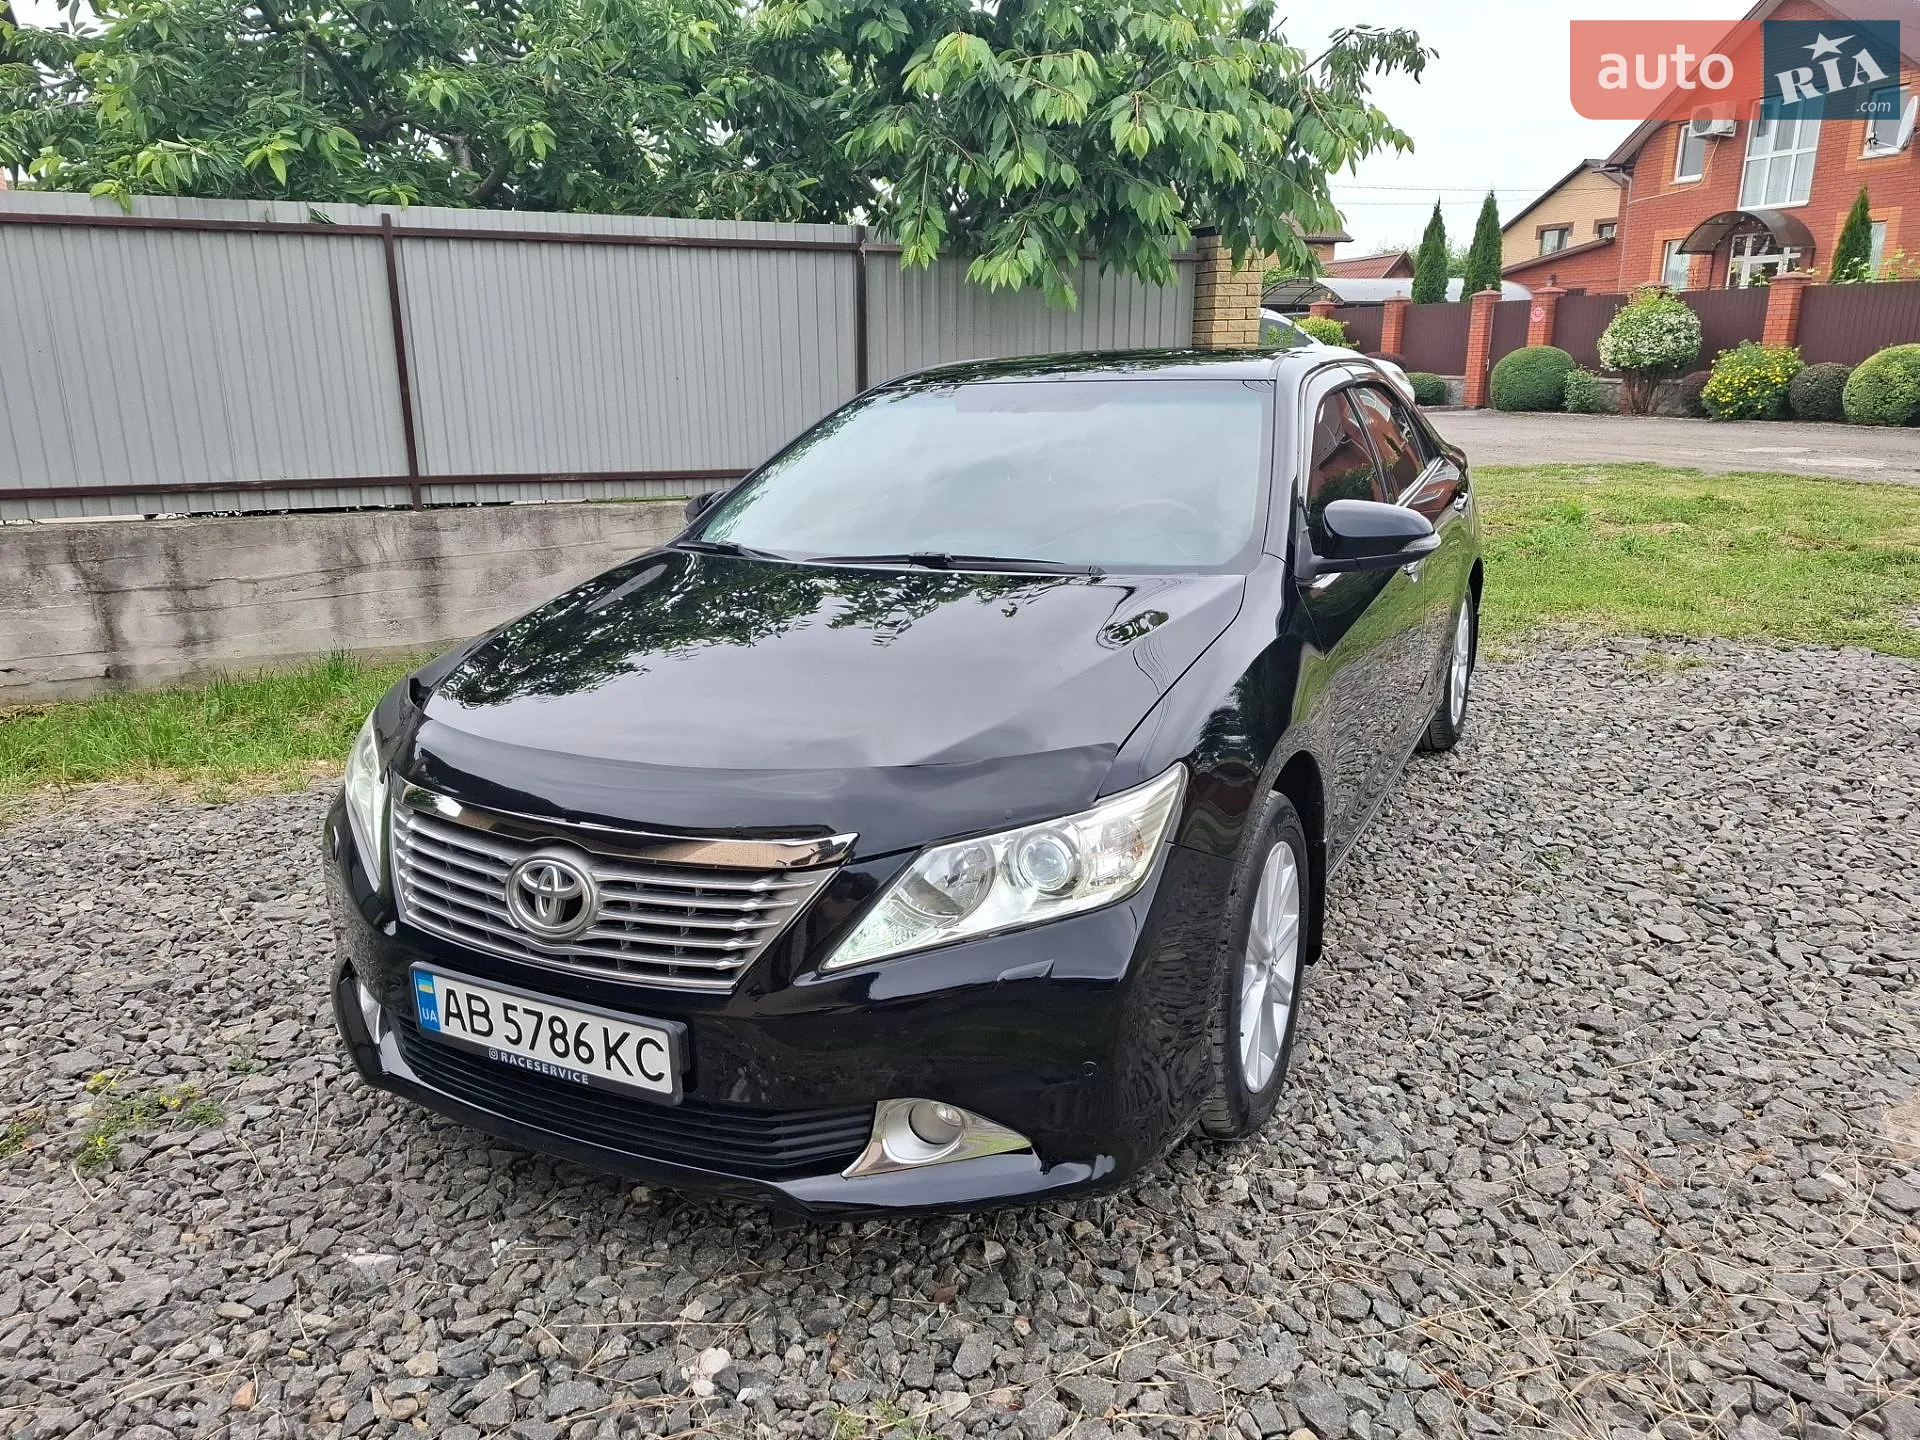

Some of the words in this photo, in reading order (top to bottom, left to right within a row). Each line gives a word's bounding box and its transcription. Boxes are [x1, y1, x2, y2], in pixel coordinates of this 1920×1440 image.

[422, 1007, 438, 1024] UA
[444, 988, 493, 1037] AB
[503, 1003, 595, 1065] 5786
[602, 1026, 665, 1082] KC
[501, 1051, 589, 1085] RACESERVICE
